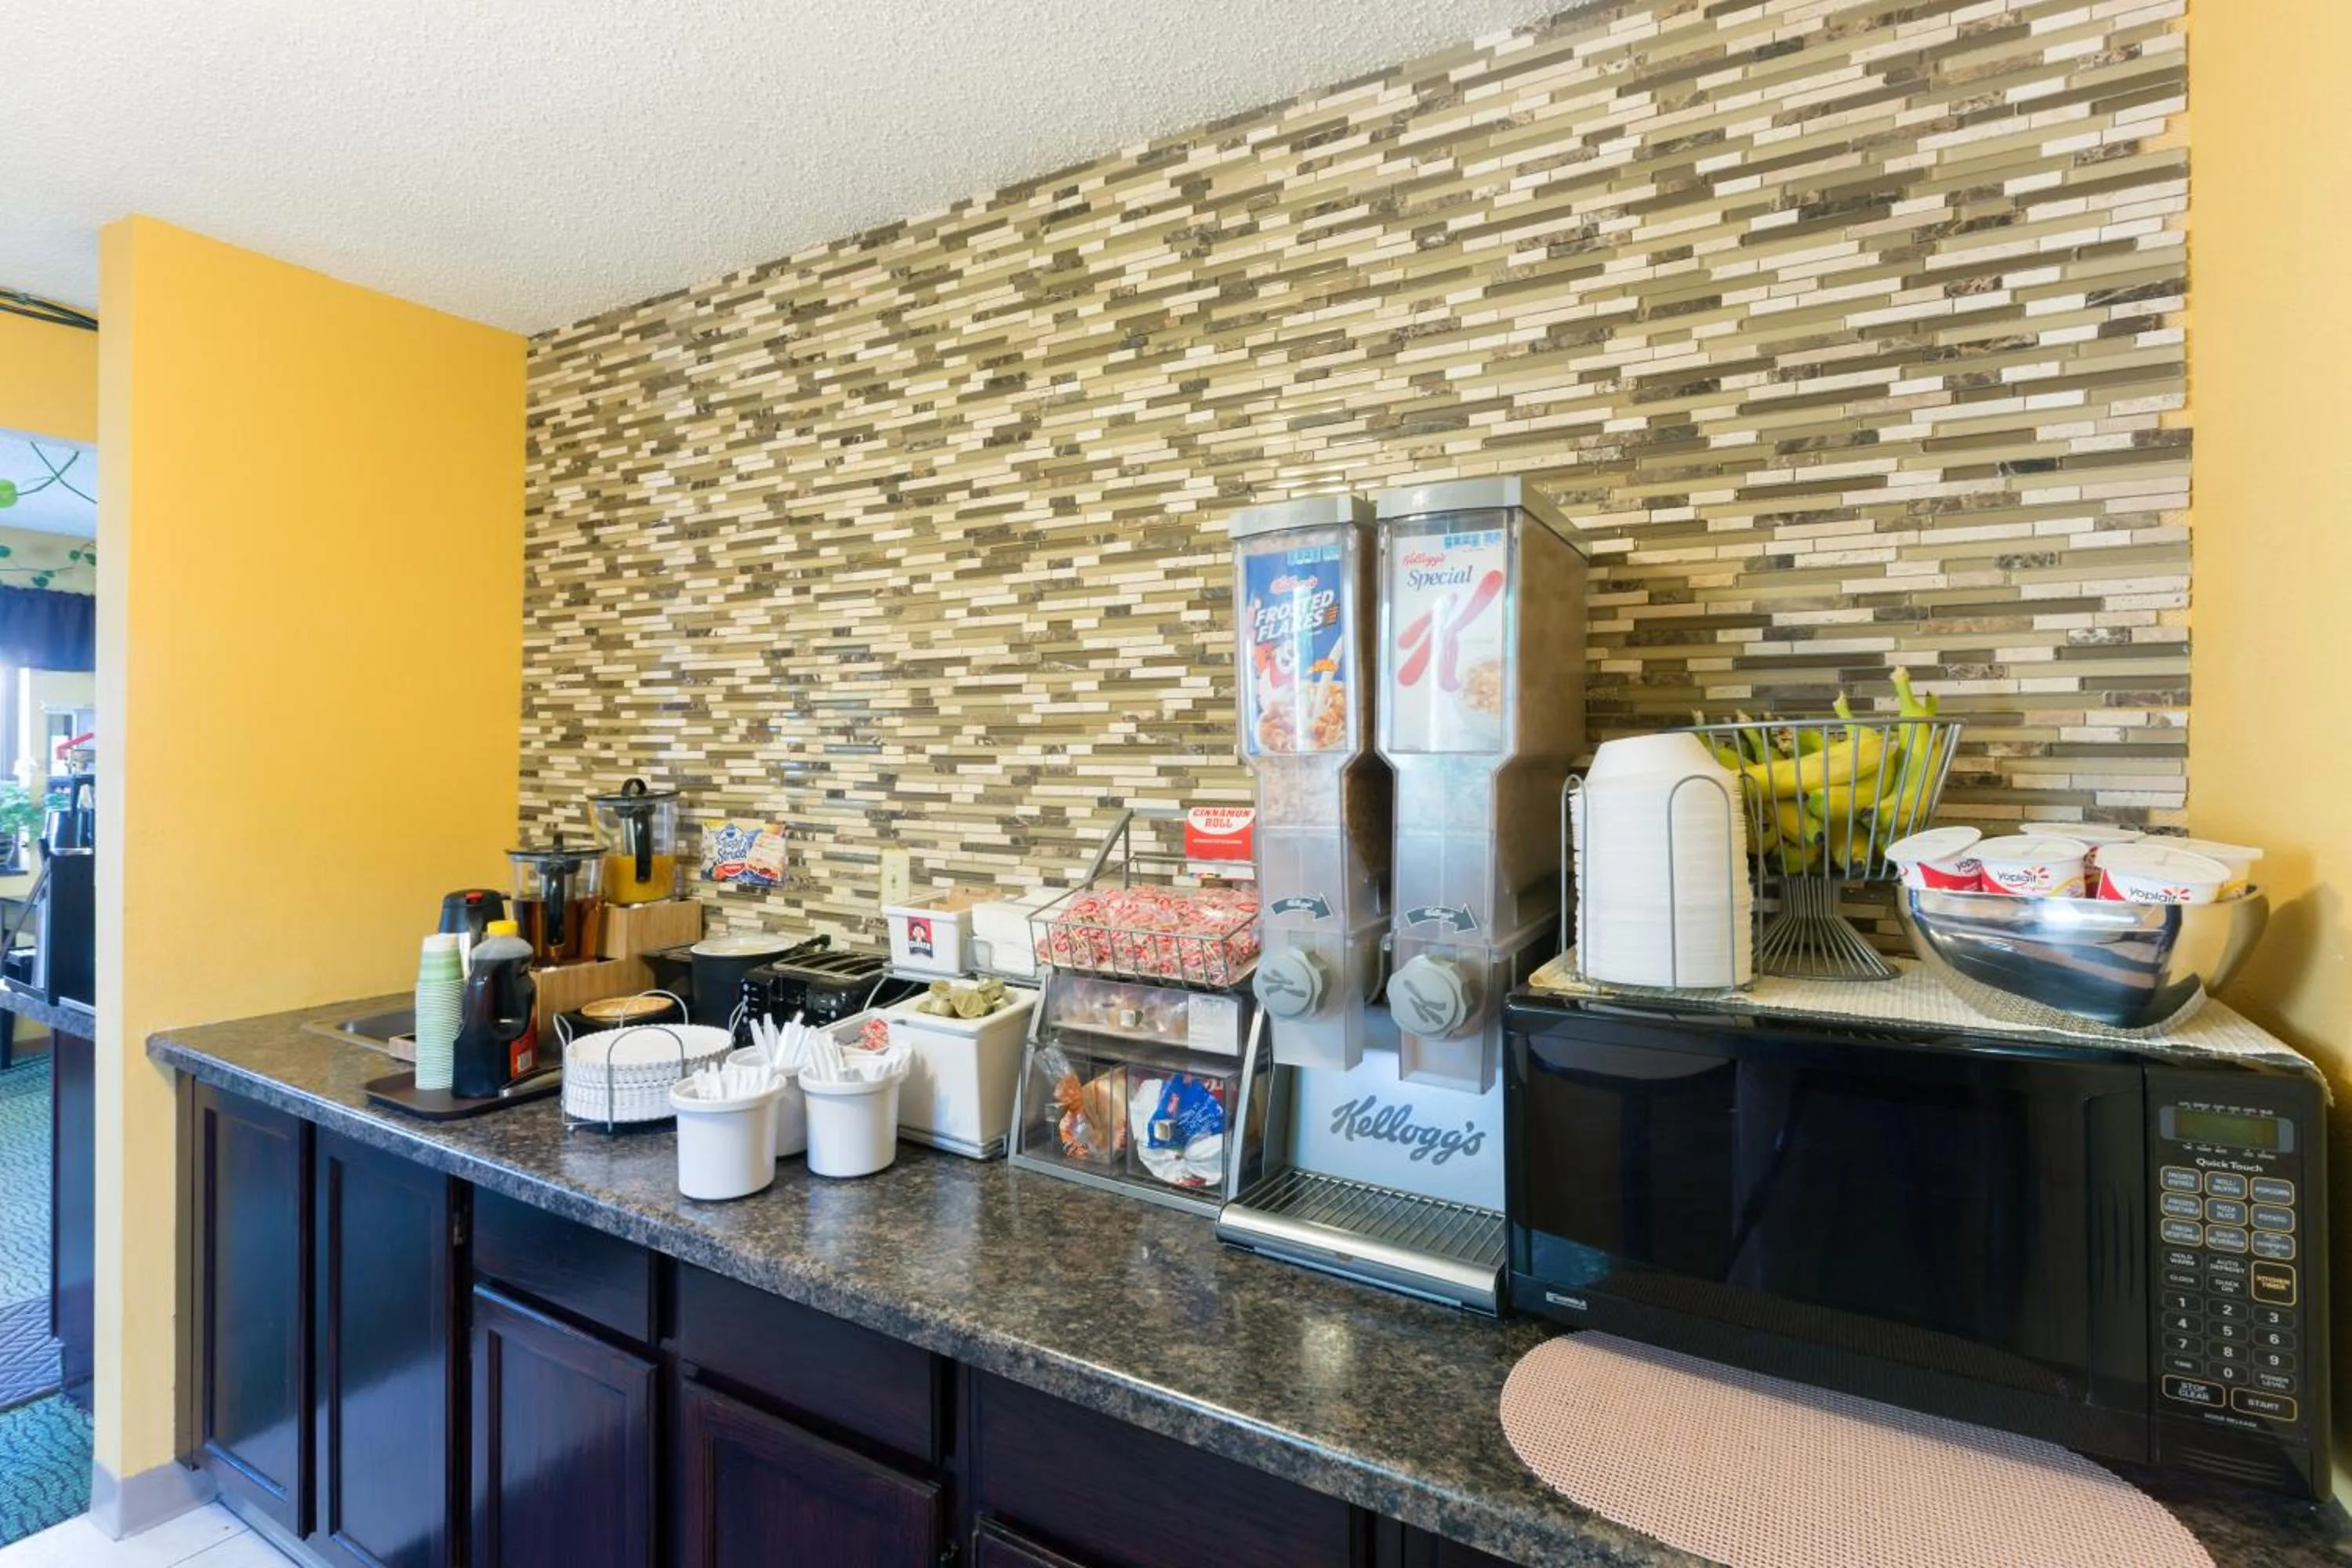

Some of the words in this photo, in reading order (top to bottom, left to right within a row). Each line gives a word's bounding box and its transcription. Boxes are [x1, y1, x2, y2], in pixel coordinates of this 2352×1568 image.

[1407, 564, 1474, 590] Special
[1257, 610, 1324, 643] FLAES
[1192, 808, 1252, 817] CINNAMON
[1204, 818, 1233, 829] ROLL
[1330, 1095, 1486, 1166] Kellogg's
[2196, 1158, 2228, 1168] Quick
[2230, 1161, 2263, 1173] Touch
[2178, 1298, 2186, 1308] 1
[2222, 1305, 2233, 1316] 2
[2269, 1312, 2280, 1323] 3
[2177, 1318, 2188, 1329] 4
[2223, 1326, 2234, 1337] 5
[2178, 1338, 2188, 1349] 7
[2269, 1334, 2280, 1345] 6
[2223, 1346, 2234, 1357] 8
[2269, 1355, 2280, 1366] 9
[2223, 1367, 2234, 1378] 0
[2178, 1388, 2211, 1402] CLEAR
[2248, 1398, 2280, 1410] START
